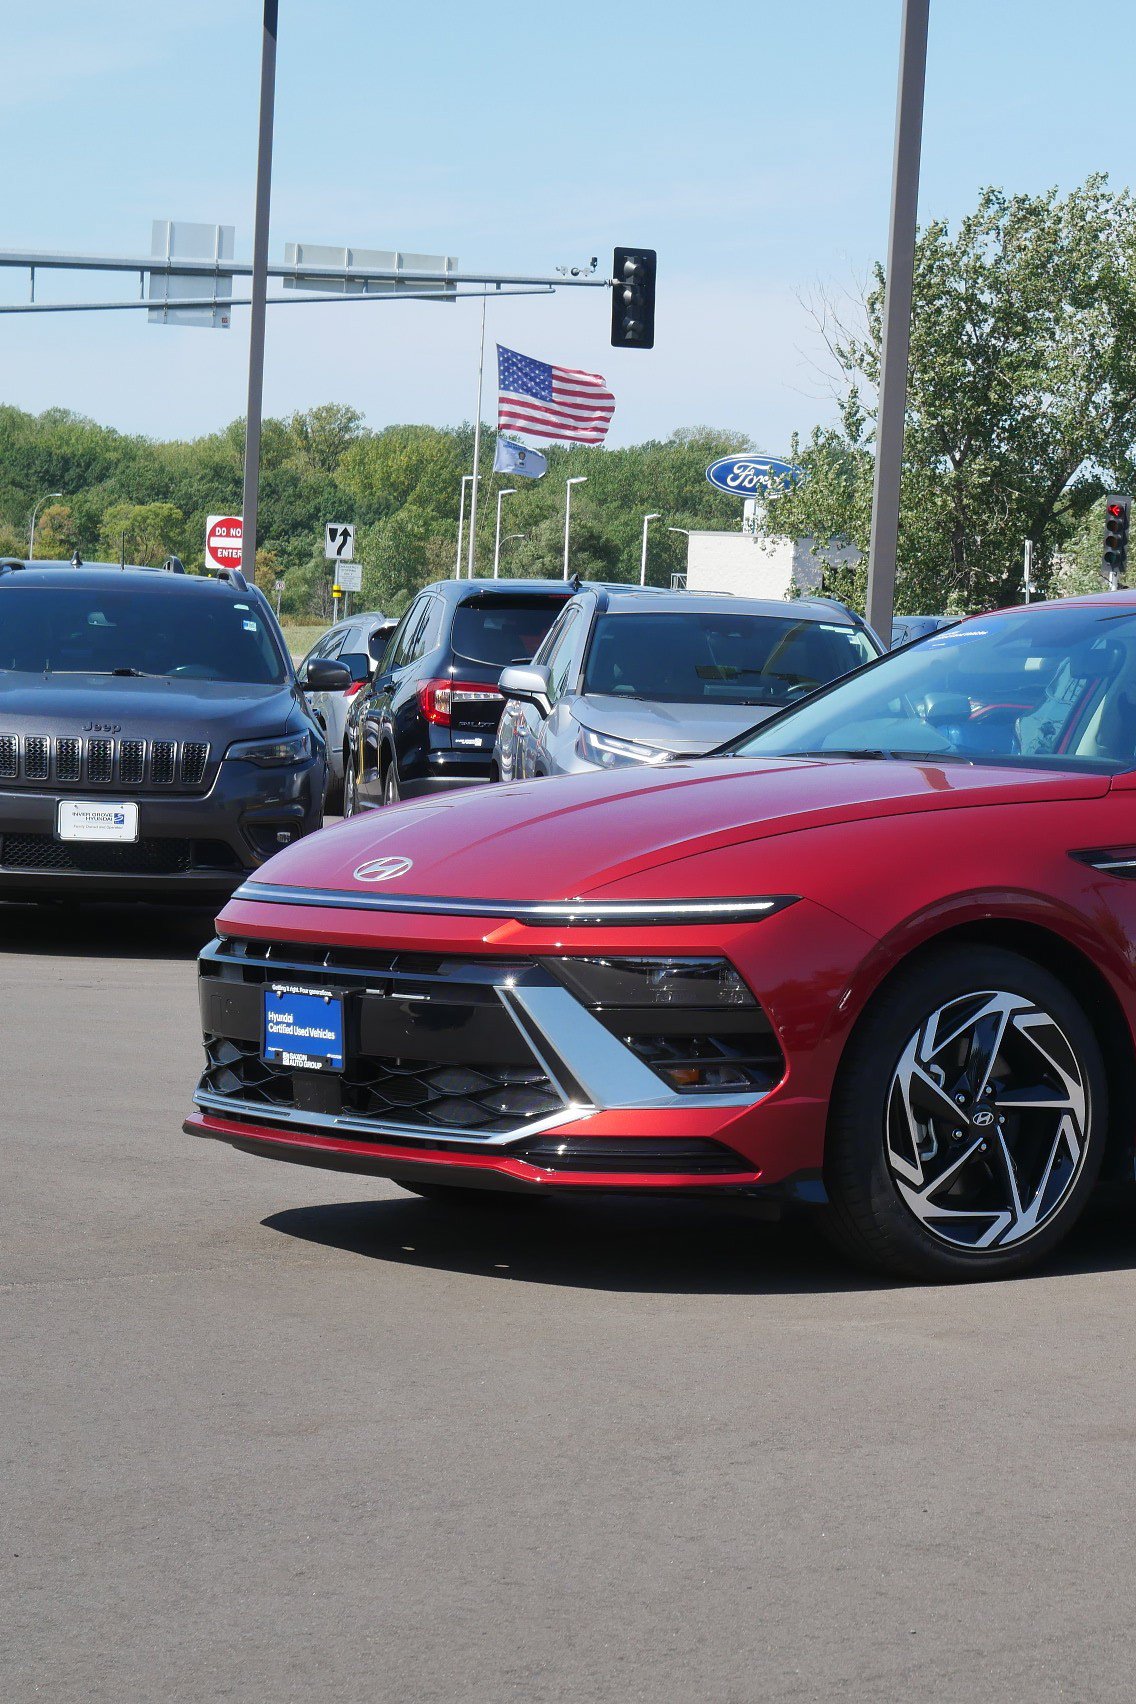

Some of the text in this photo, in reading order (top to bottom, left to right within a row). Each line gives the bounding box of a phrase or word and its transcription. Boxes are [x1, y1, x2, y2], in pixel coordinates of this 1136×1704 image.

[215, 527, 242, 537] DO NO
[82, 721, 122, 734] Jeep
[268, 1011, 294, 1023] Hyundai
[268, 1023, 336, 1040] Certified Used Vehicles
[289, 1059, 323, 1070] AUTO GROUP
